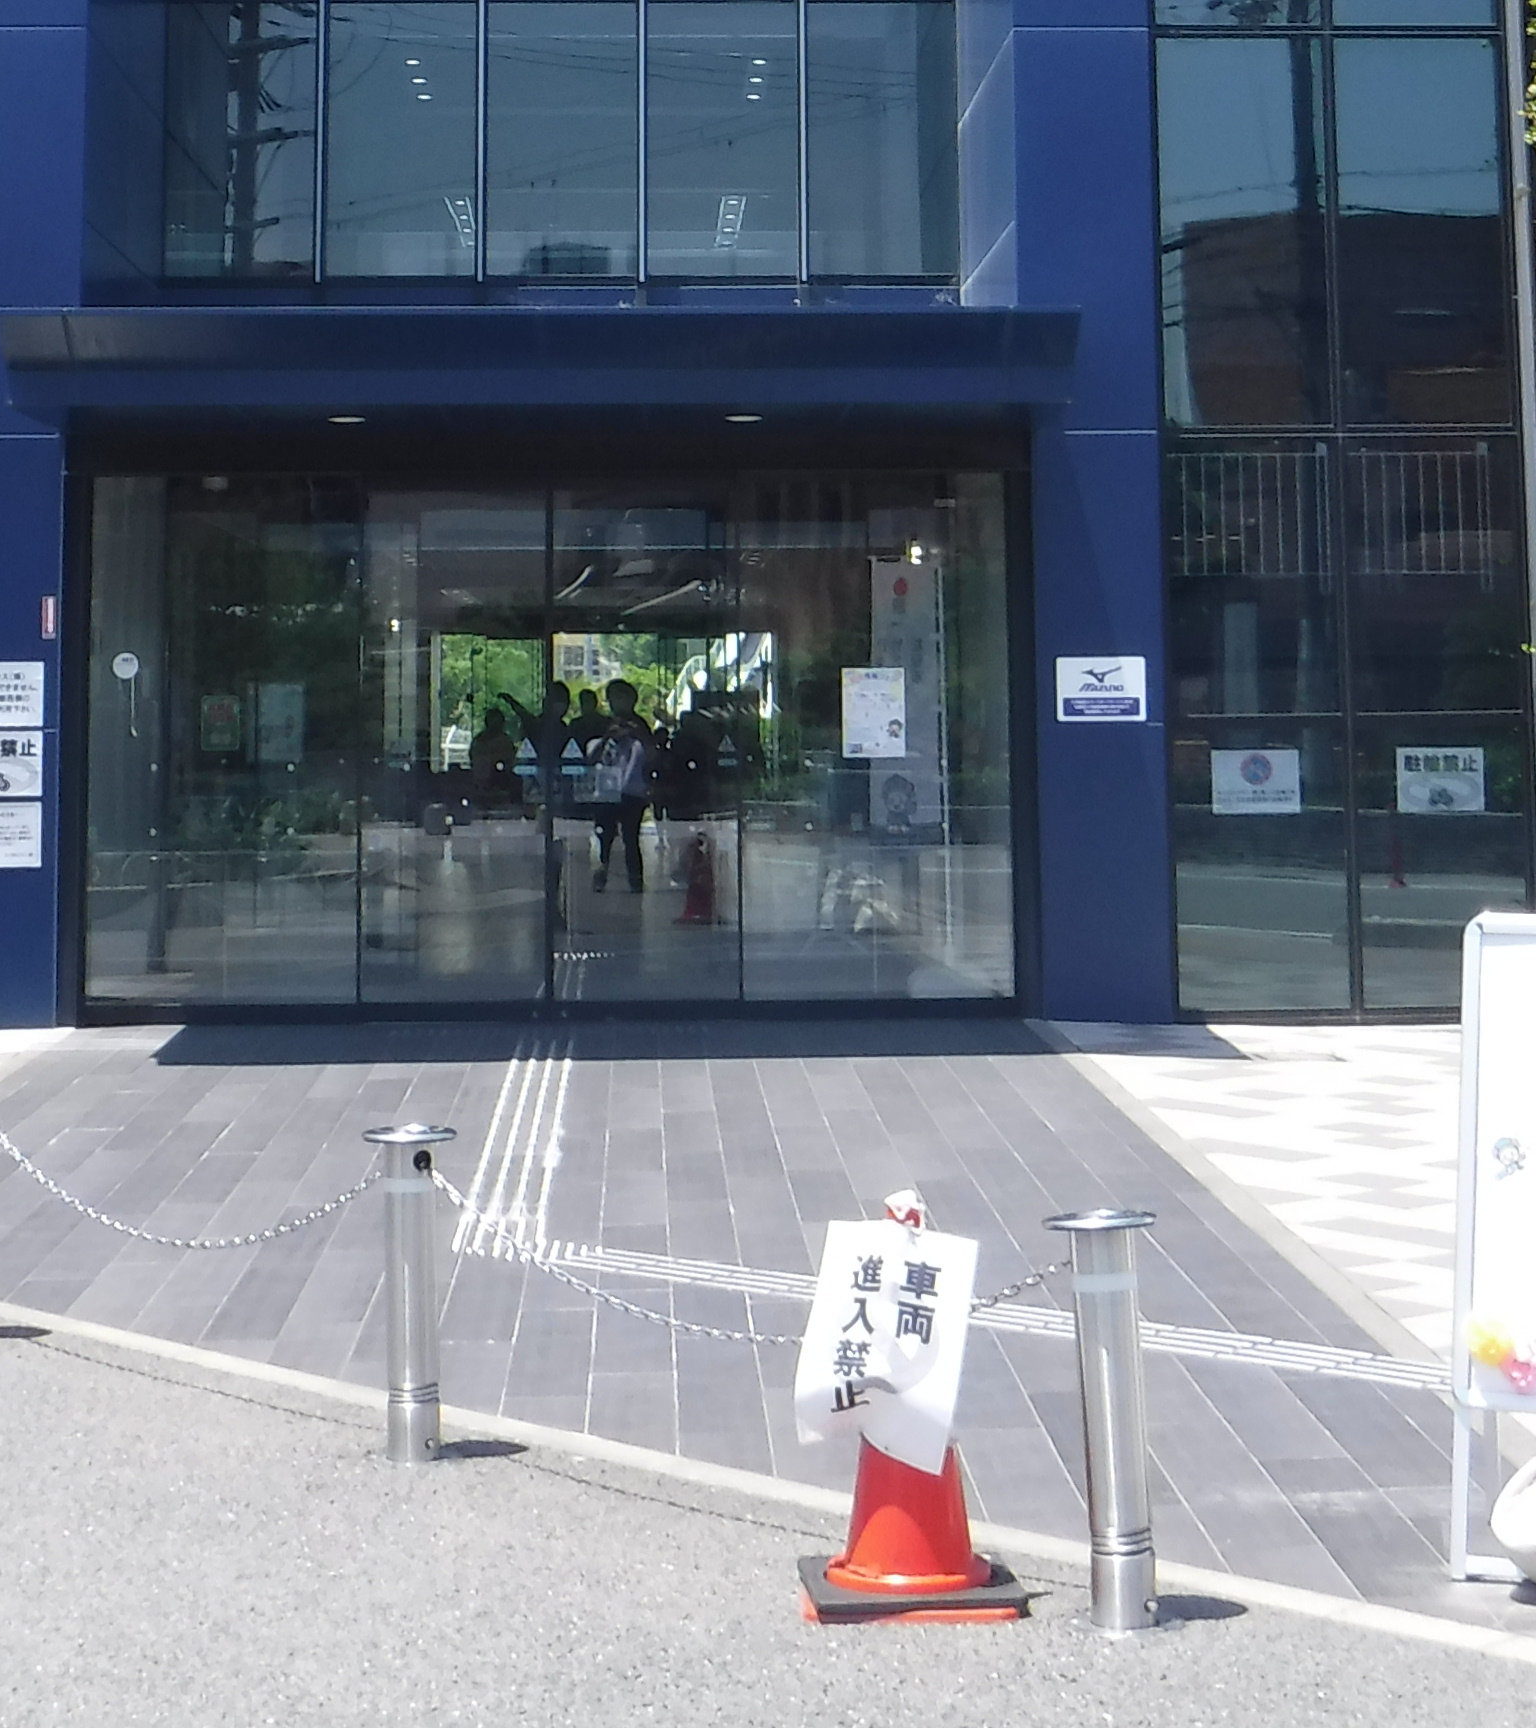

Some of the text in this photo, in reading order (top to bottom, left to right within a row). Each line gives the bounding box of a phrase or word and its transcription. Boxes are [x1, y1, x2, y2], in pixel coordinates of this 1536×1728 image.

[830, 1254, 884, 1414] 進入禁止
[895, 1260, 942, 1345] 車両
